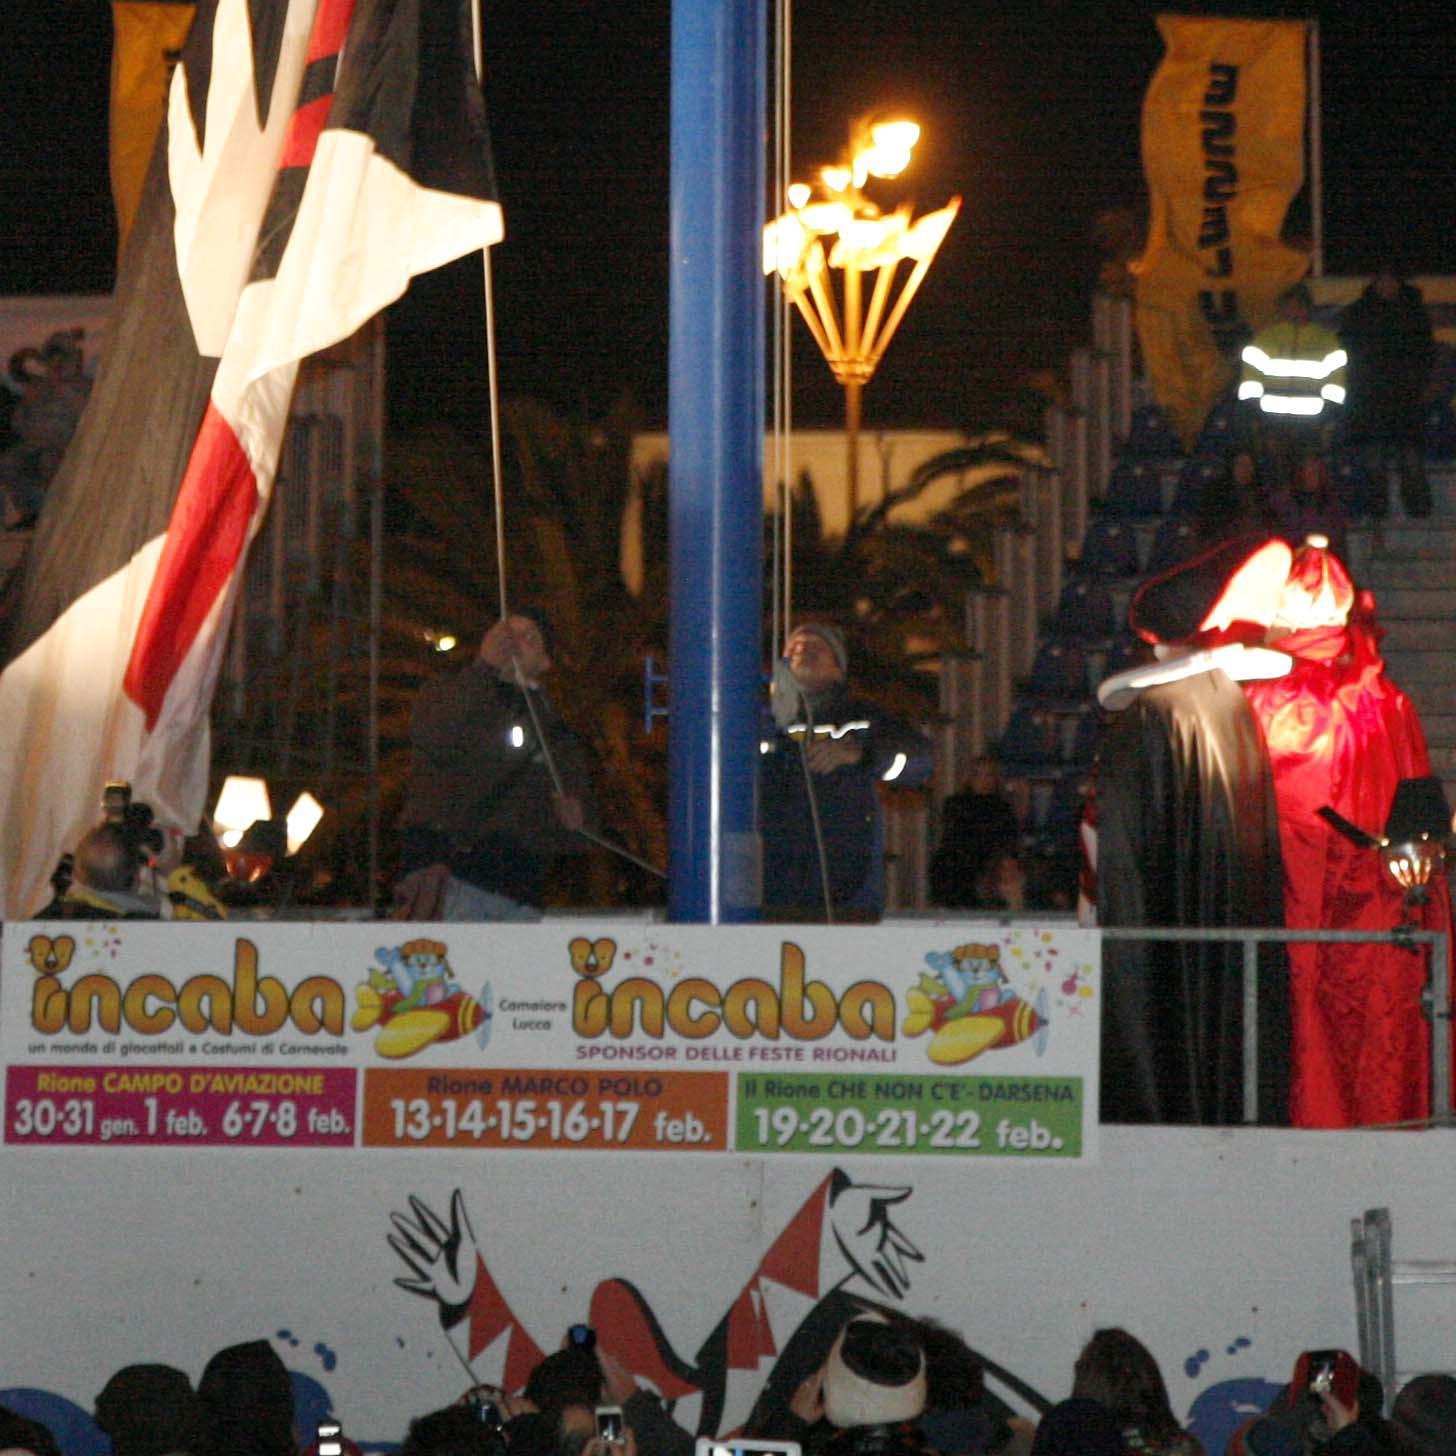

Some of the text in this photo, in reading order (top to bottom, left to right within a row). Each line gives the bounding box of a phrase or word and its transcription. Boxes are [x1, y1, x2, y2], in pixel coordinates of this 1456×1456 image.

[28, 934, 344, 1036] incaba
[568, 937, 896, 1043] incaba
[512, 1019, 552, 1032] Lucca
[27, 1044, 45, 1055] un
[51, 1042, 98, 1055] mondo
[576, 1045, 897, 1063] SPONSOR DELLE FESTE RIONALI
[37, 1072, 326, 1095] Rione CAMPO D'AVIAZIONE
[428, 1076, 664, 1097] Rione MARCO POLO
[765, 1080, 821, 1099] Rione
[828, 1081, 868, 1099] CHE
[875, 1082, 923, 1100] NON
[100, 1118, 140, 1141] gen.
[144, 1097, 158, 1135] 1
[165, 1110, 209, 1136] feb.
[308, 1109, 352, 1135] feb.
[653, 1111, 713, 1143] feb.
[996, 1118, 1064, 1151] feb.
